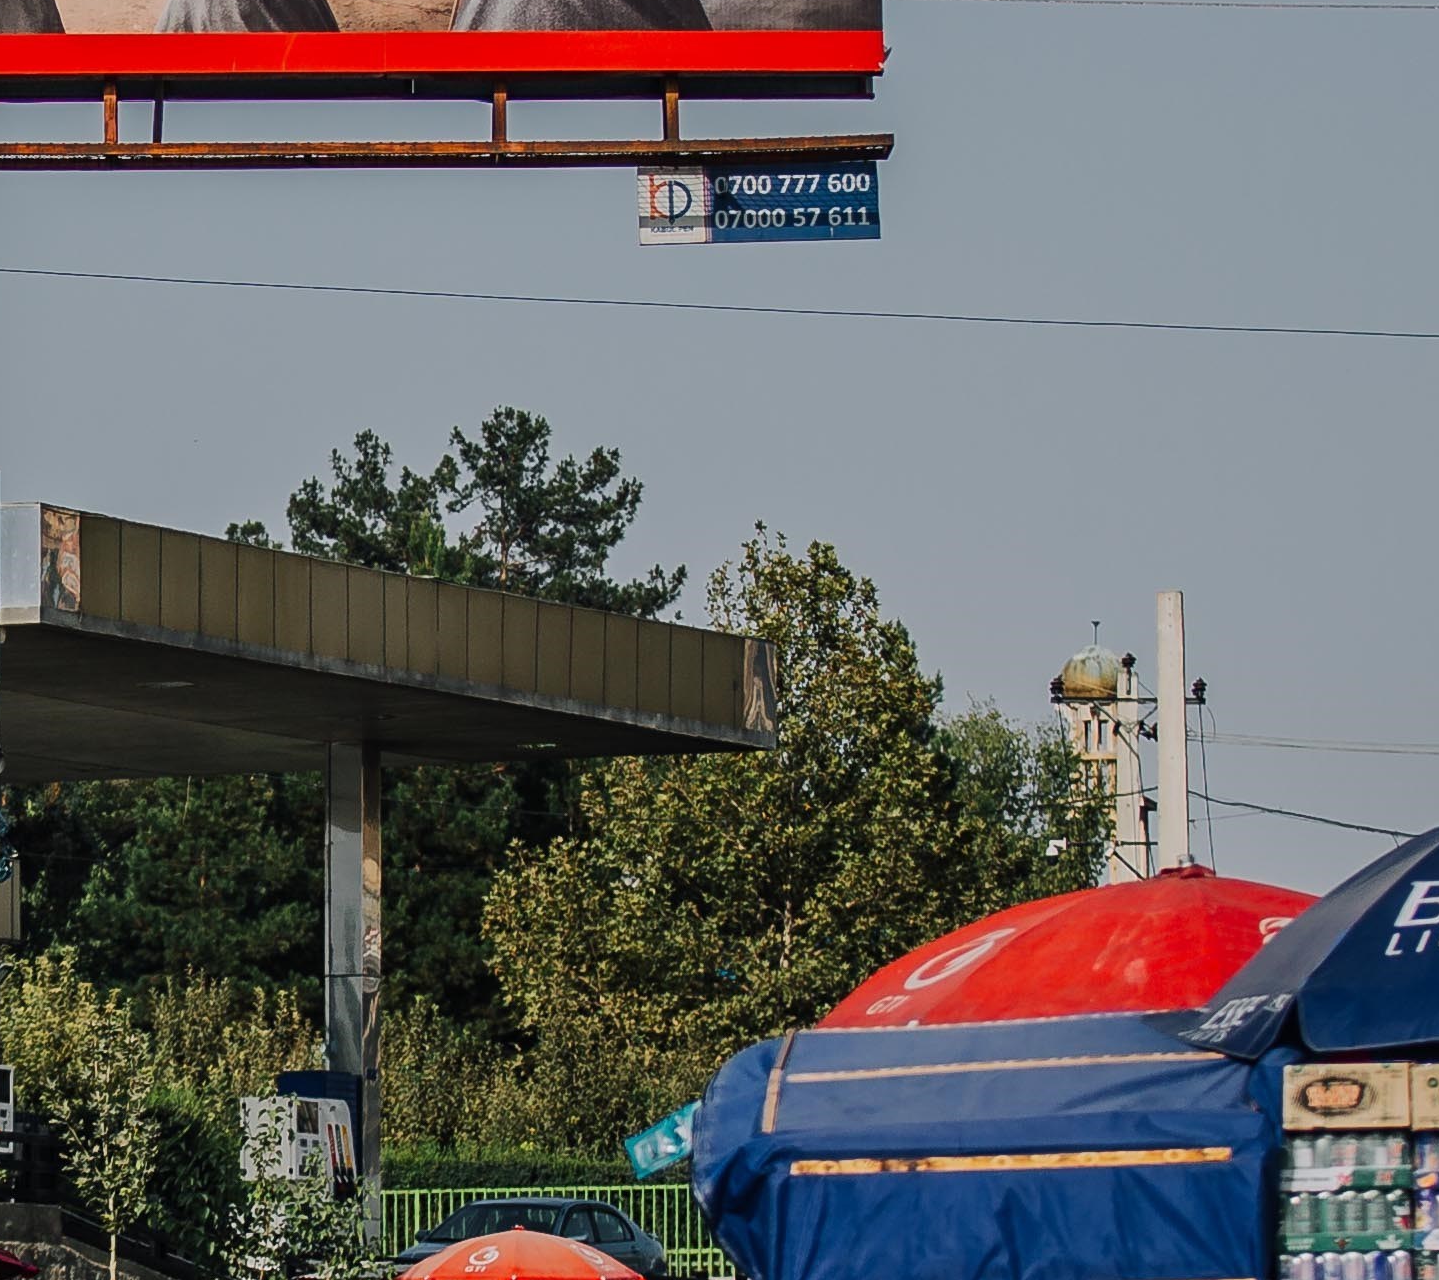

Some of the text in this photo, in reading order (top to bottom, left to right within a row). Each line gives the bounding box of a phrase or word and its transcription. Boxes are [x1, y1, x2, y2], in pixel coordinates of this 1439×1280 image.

[714, 172, 871, 195] 0700 777 600
[714, 206, 871, 230] 07000 57 611
[464, 1265, 487, 1273] GTI
